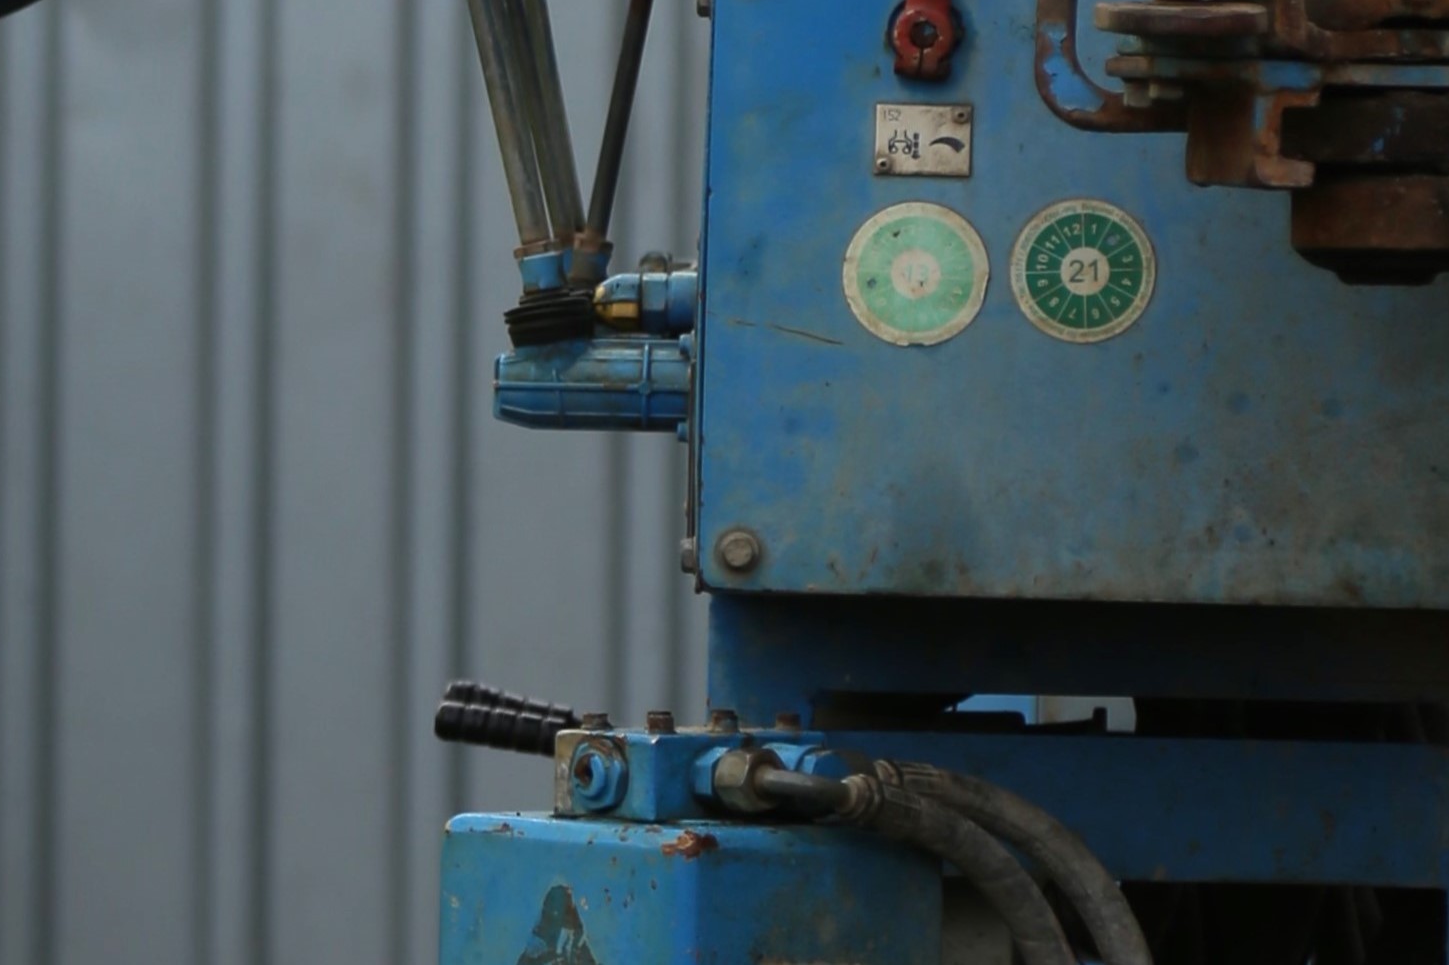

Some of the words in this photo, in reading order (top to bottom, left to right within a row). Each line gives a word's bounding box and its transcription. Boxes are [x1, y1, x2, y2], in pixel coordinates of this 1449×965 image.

[883, 108, 901, 122] 152
[1063, 223, 1082, 237] 12
[1090, 223, 1098, 234] 1
[1045, 235, 1061, 250] 11
[1036, 253, 1049, 271] 10
[1068, 259, 1099, 283] 21
